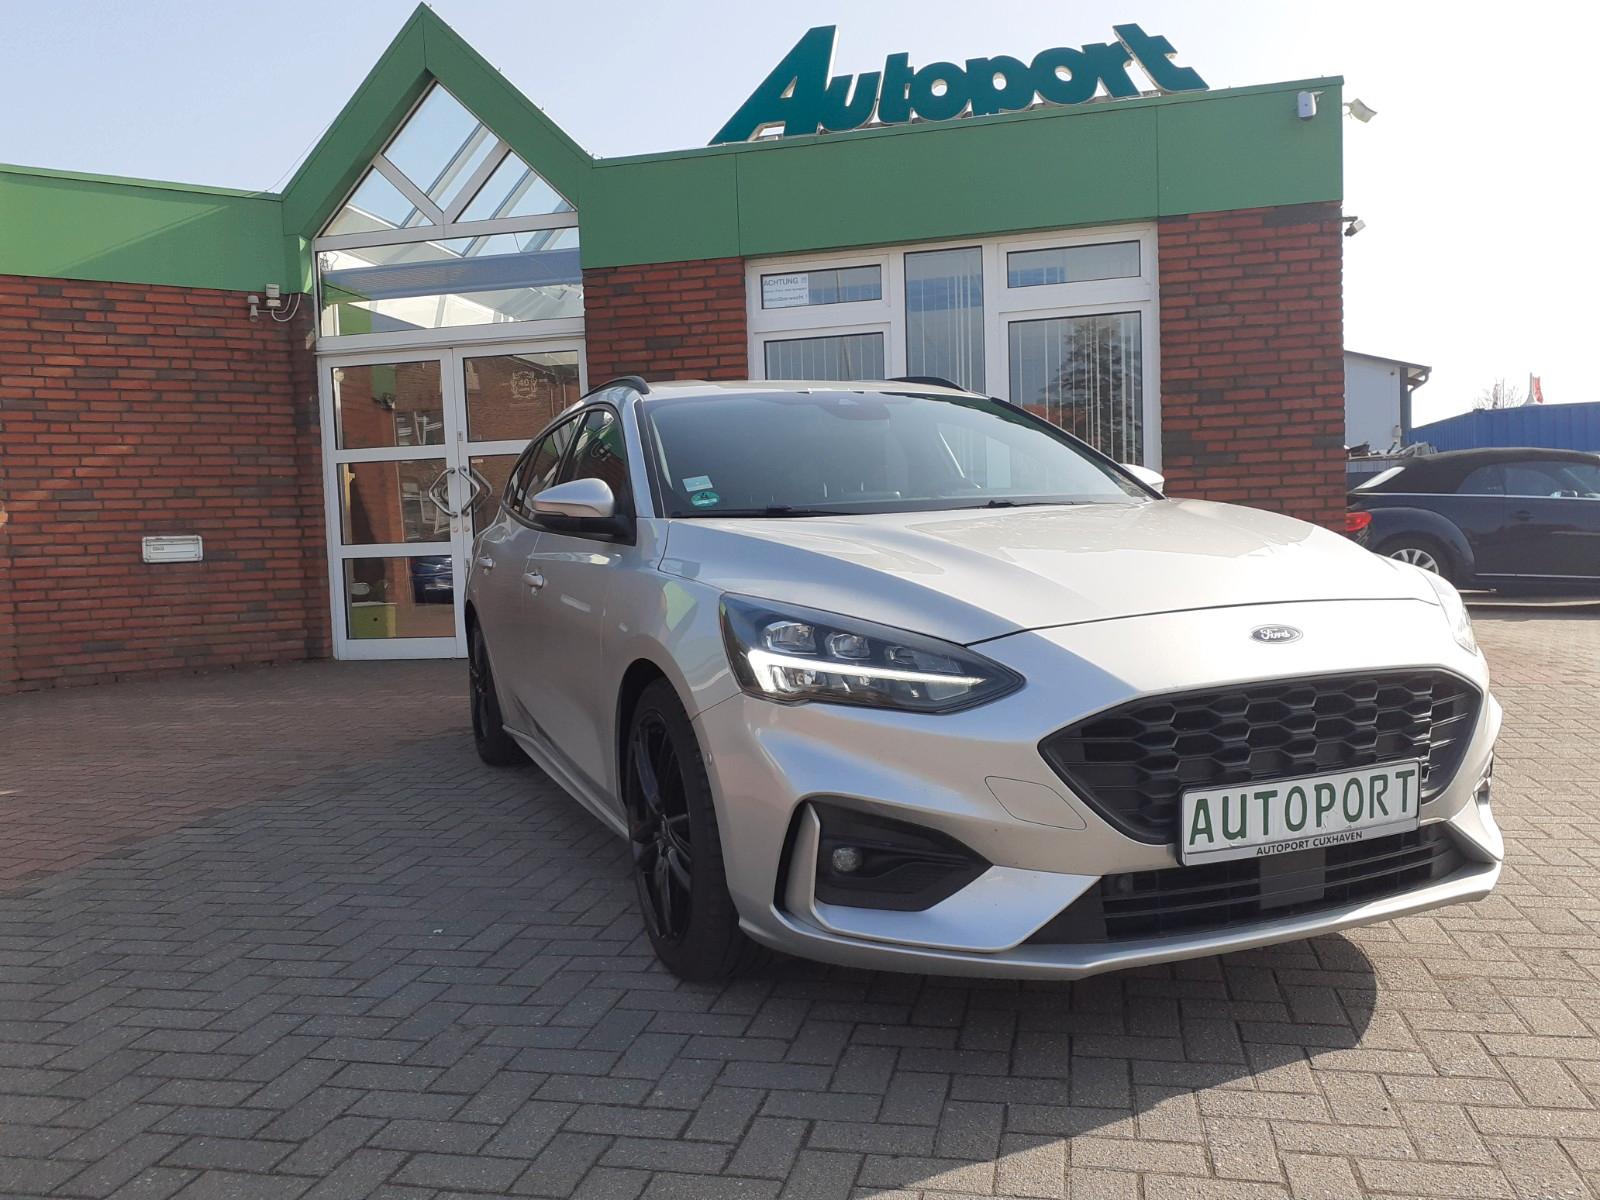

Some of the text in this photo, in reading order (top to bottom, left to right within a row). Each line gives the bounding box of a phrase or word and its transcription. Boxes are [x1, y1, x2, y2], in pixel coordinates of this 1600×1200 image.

[707, 23, 1209, 145] Autoport
[763, 277, 799, 286] ACHTUNG
[1260, 628, 1291, 640] Ford
[1189, 769, 1415, 846] AUTOPORT
[1256, 831, 1362, 856] AUTOPORT CUXHAVEN
